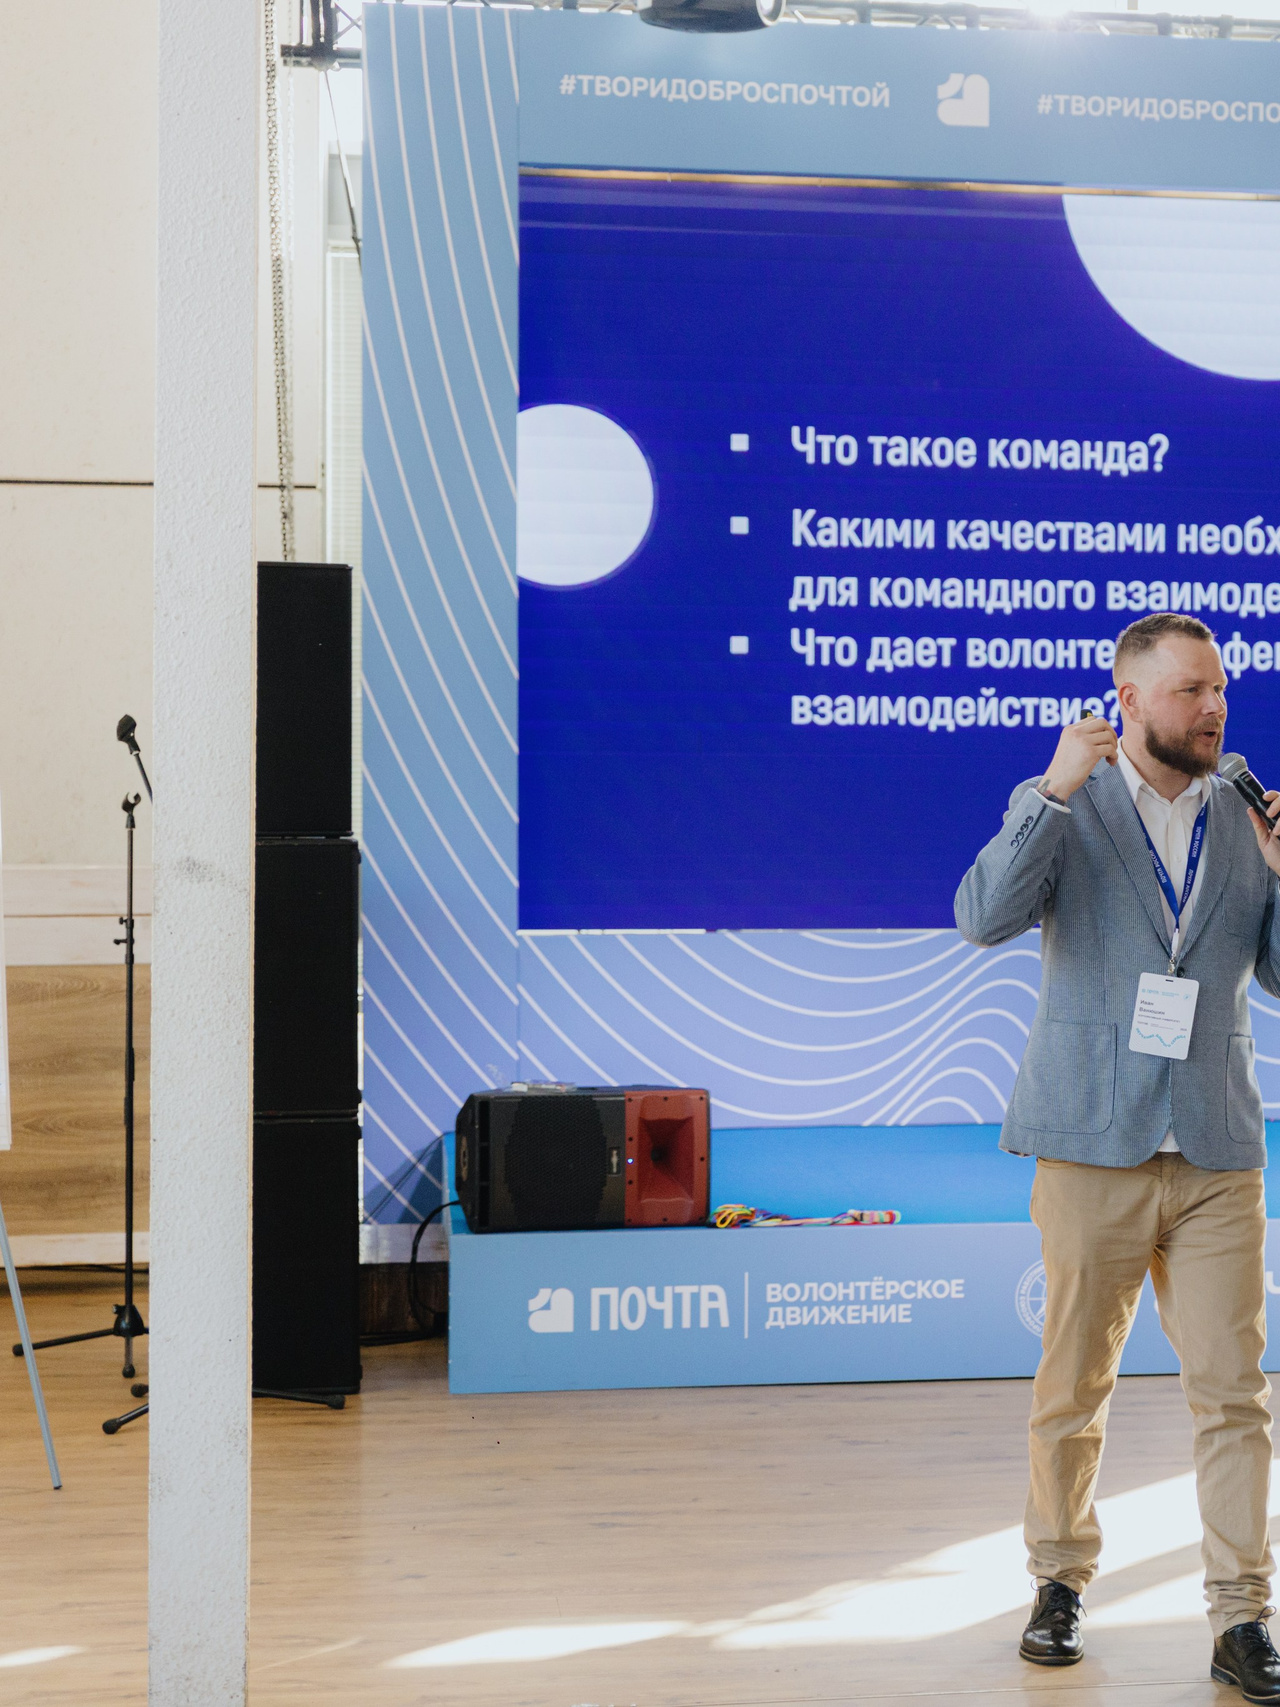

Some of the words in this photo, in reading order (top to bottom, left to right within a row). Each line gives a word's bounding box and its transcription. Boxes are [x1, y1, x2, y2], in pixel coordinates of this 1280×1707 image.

[559, 73, 890, 108] #ТВОРИДОБРОСПОЧТОЙ
[791, 426, 858, 465] Что
[867, 435, 977, 468] такое
[988, 433, 1169, 476] команда?
[792, 509, 935, 549] Какими
[946, 519, 1166, 553] качествами
[788, 576, 858, 612] для
[870, 576, 1095, 614] командного
[791, 628, 858, 667] Что
[866, 637, 957, 672] дает
[966, 638, 1116, 669] волонте
[590, 1284, 730, 1331] ПОЧТА
[766, 1276, 965, 1302] ВОЛОНТЁРСКОЕ
[765, 1303, 912, 1330] ДВИЖЕНИЕ
